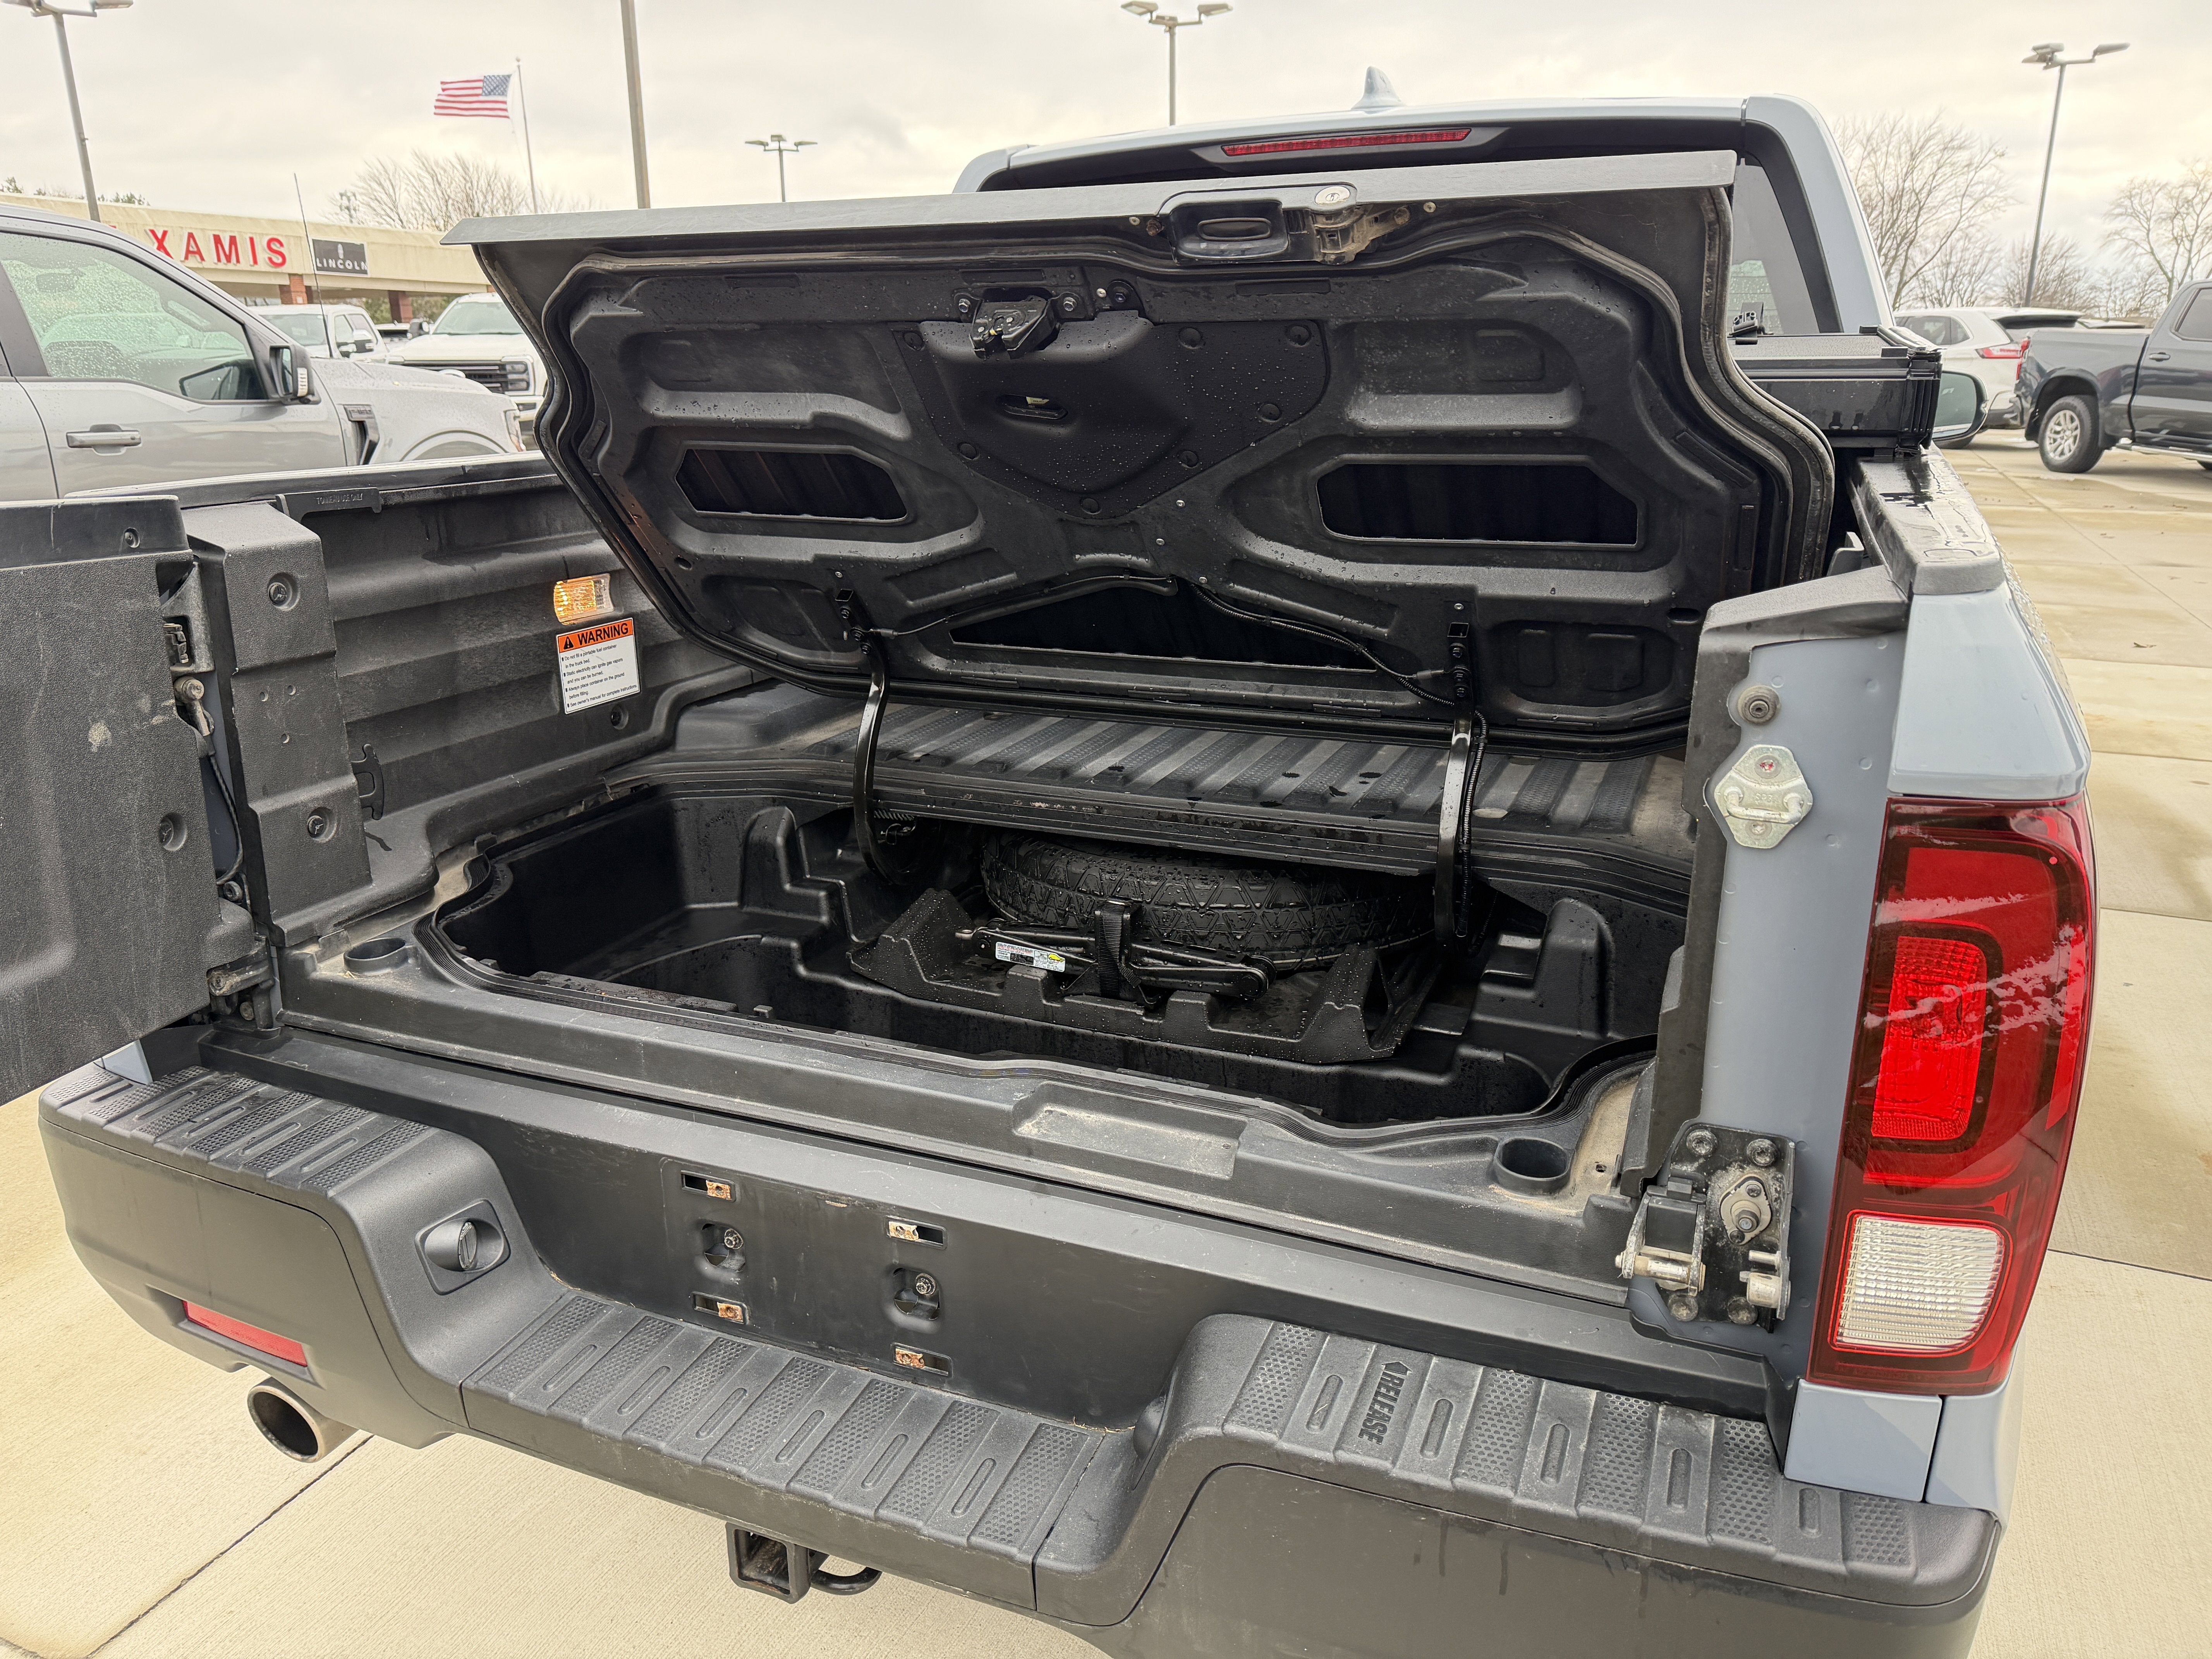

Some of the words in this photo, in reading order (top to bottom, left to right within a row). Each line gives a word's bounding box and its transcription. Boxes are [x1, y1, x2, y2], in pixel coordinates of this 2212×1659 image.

[316, 258, 368, 270] LINCOLN
[351, 493, 363, 501] ONLY
[577, 623, 628, 645] WARNING
[1358, 1371, 1405, 1445] RELEASE
